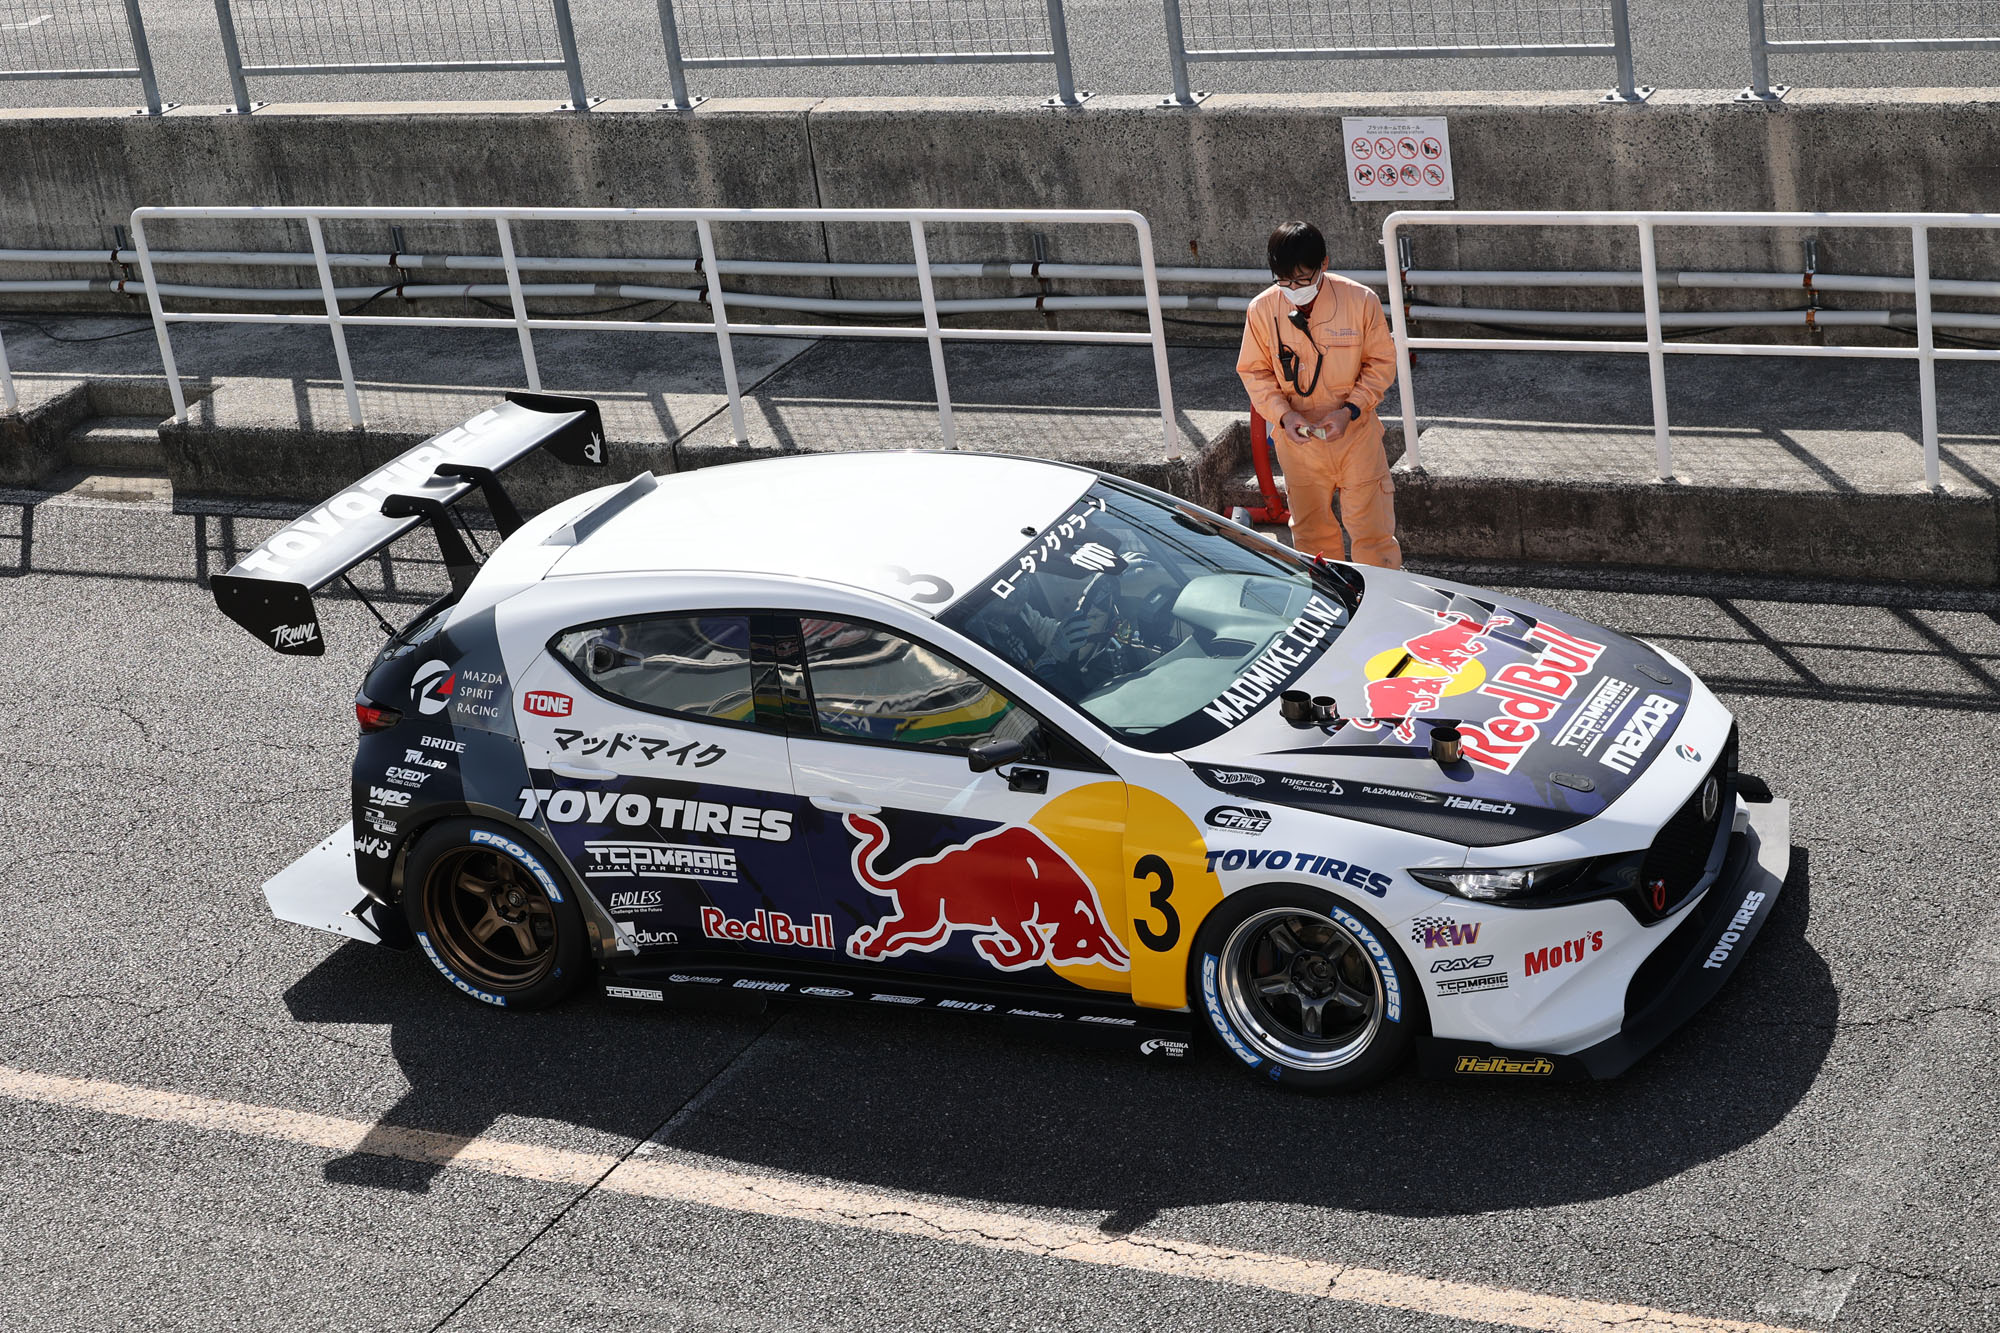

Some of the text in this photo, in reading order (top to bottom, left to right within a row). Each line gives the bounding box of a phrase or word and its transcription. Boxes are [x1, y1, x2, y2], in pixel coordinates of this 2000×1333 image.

[239, 491, 382, 574] TOYO
[990, 498, 1106, 600] ロータングクラーン
[884, 565, 955, 604] 3
[1202, 595, 1343, 729] MADMIKE.CO.NZ
[462, 670, 503, 685] MAZDA
[460, 686, 494, 701] SPIRIT
[1455, 620, 1607, 775] Red Bull
[456, 702, 499, 718] RACING
[528, 694, 570, 714] TONE
[1577, 684, 1633, 752] TOTAL CAR PRODUCE
[420, 735, 467, 753] BRIDE
[553, 728, 727, 768] マッドマイク
[385, 766, 431, 783] EXEDY
[1281, 776, 1330, 789] Injector
[1293, 785, 1328, 794] Dynamics
[518, 788, 793, 842] TOYO TIRES
[1443, 795, 1516, 815] Haltech
[472, 831, 561, 901] PROXES
[675, 866, 737, 877] PRODUCE
[1205, 849, 1393, 899] TOYO TIRES
[610, 890, 662, 907] ENDLESS
[1133, 854, 1180, 952] 3
[700, 905, 836, 950] Red Bull
[1424, 922, 1482, 949] KW
[1702, 890, 1766, 969] TOYO TIRES
[1430, 954, 1494, 973] RAYS
[1524, 930, 1603, 977] Moty's
[417, 934, 505, 1006] TOYO TIRES
[1333, 908, 1400, 1020] TOYO TIRES
[668, 974, 723, 984] HOLINGER
[732, 979, 791, 992] Garrett
[936, 999, 996, 1011] Moty's
[1006, 1008, 1065, 1019] Haltech
[1203, 955, 1258, 1064] PROXES
[1159, 1040, 1189, 1049] SUZUKA
[1165, 1046, 1184, 1054] TWIN
[1457, 1057, 1553, 1074] Haltech
